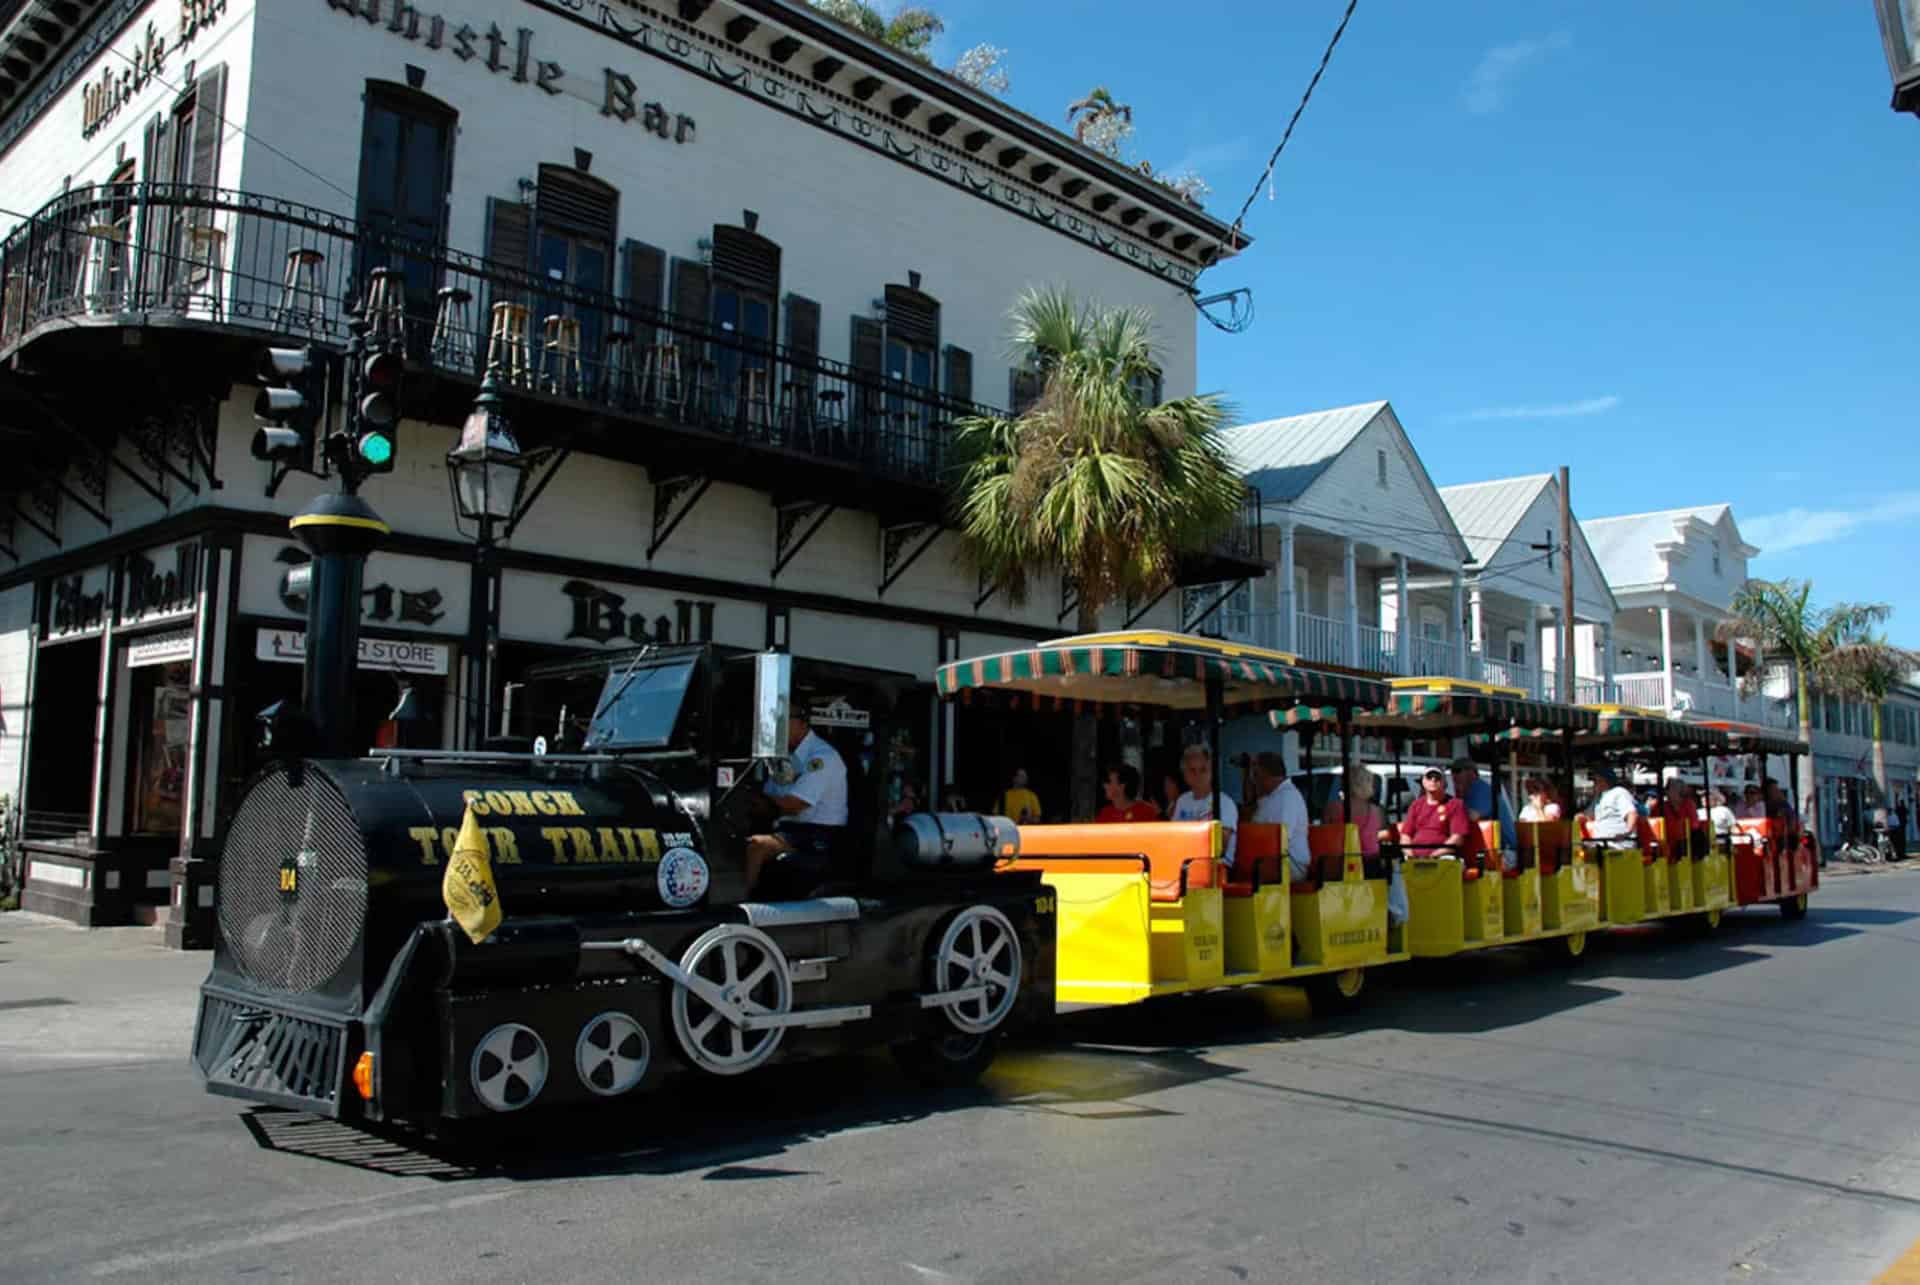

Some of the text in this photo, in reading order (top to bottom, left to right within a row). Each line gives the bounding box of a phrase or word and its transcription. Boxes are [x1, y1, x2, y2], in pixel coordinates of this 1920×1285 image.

[599, 66, 696, 145] Bar
[561, 579, 716, 646] Bull
[372, 641, 436, 663] STORE
[463, 789, 586, 816] CONCH
[540, 826, 661, 865] TRAIN
